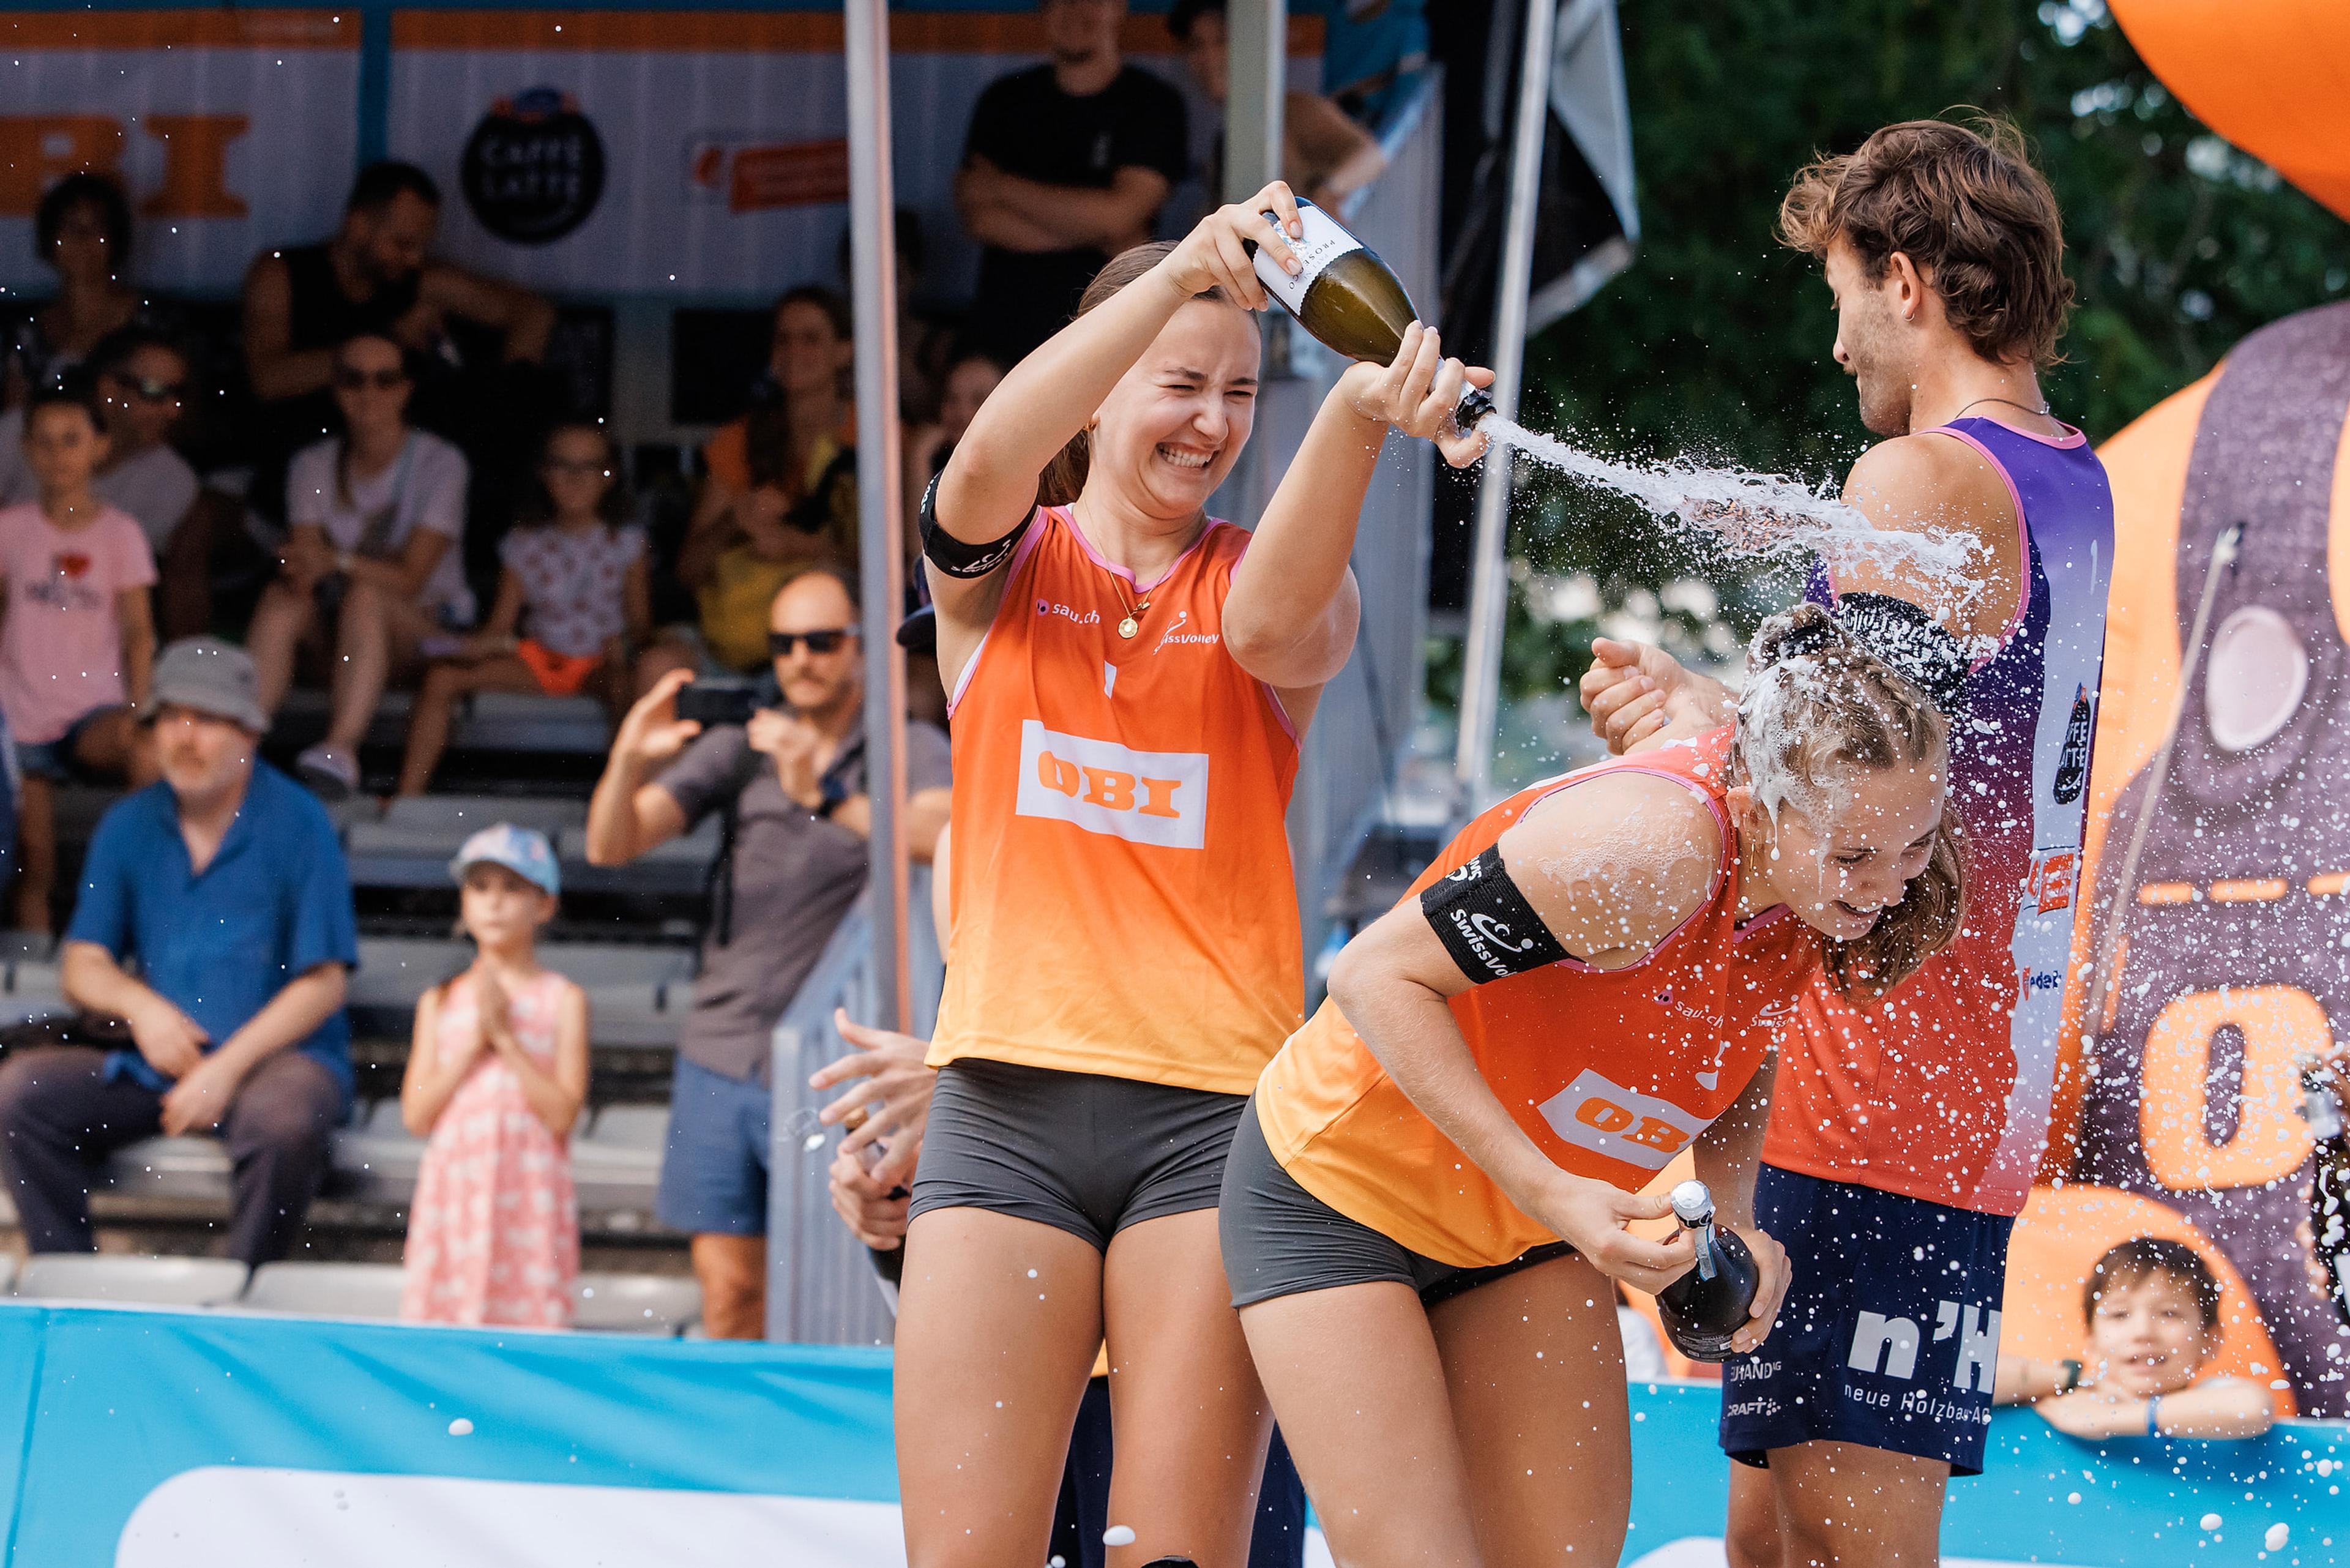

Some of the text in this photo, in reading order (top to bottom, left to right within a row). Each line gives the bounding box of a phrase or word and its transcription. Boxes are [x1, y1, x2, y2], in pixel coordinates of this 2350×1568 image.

[1052, 603, 1100, 624] sau.ch
[1038, 750, 1182, 819] OBI
[1674, 1001, 1723, 1028] sau.ch
[1751, 1014, 1792, 1028] Swiss
[1575, 1097, 1700, 1153] OB
[1845, 1384, 1890, 1407] neue
